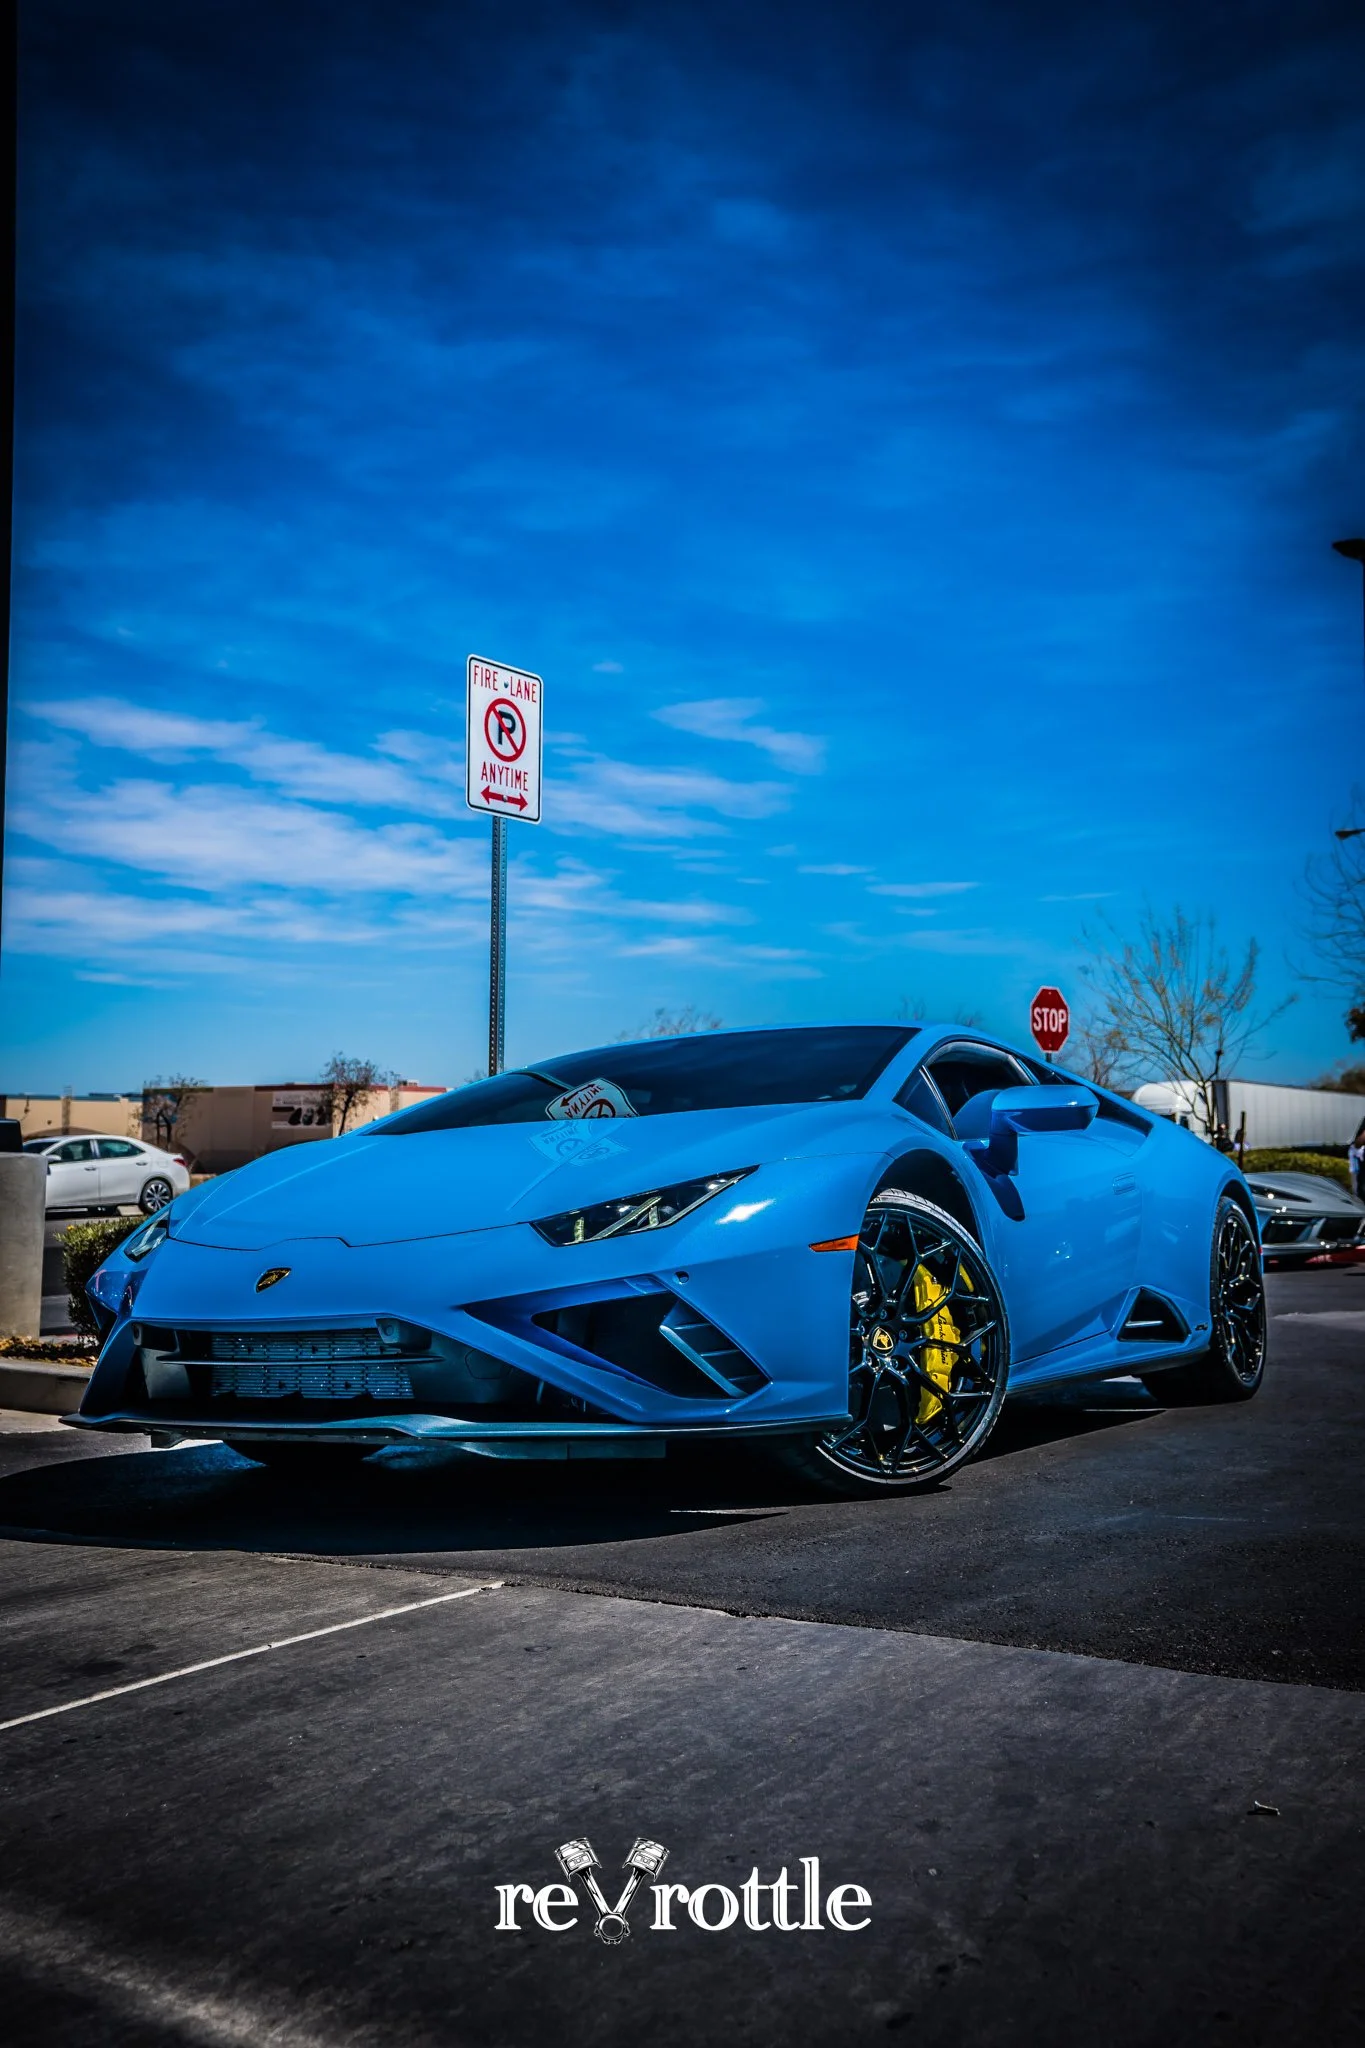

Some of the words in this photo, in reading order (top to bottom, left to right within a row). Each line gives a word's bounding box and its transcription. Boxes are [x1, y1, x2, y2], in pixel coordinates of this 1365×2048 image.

[473, 665, 499, 692] FIRE
[510, 676, 538, 703] LANE
[480, 760, 529, 792] ANYTIME
[1033, 1006, 1067, 1033] STOP
